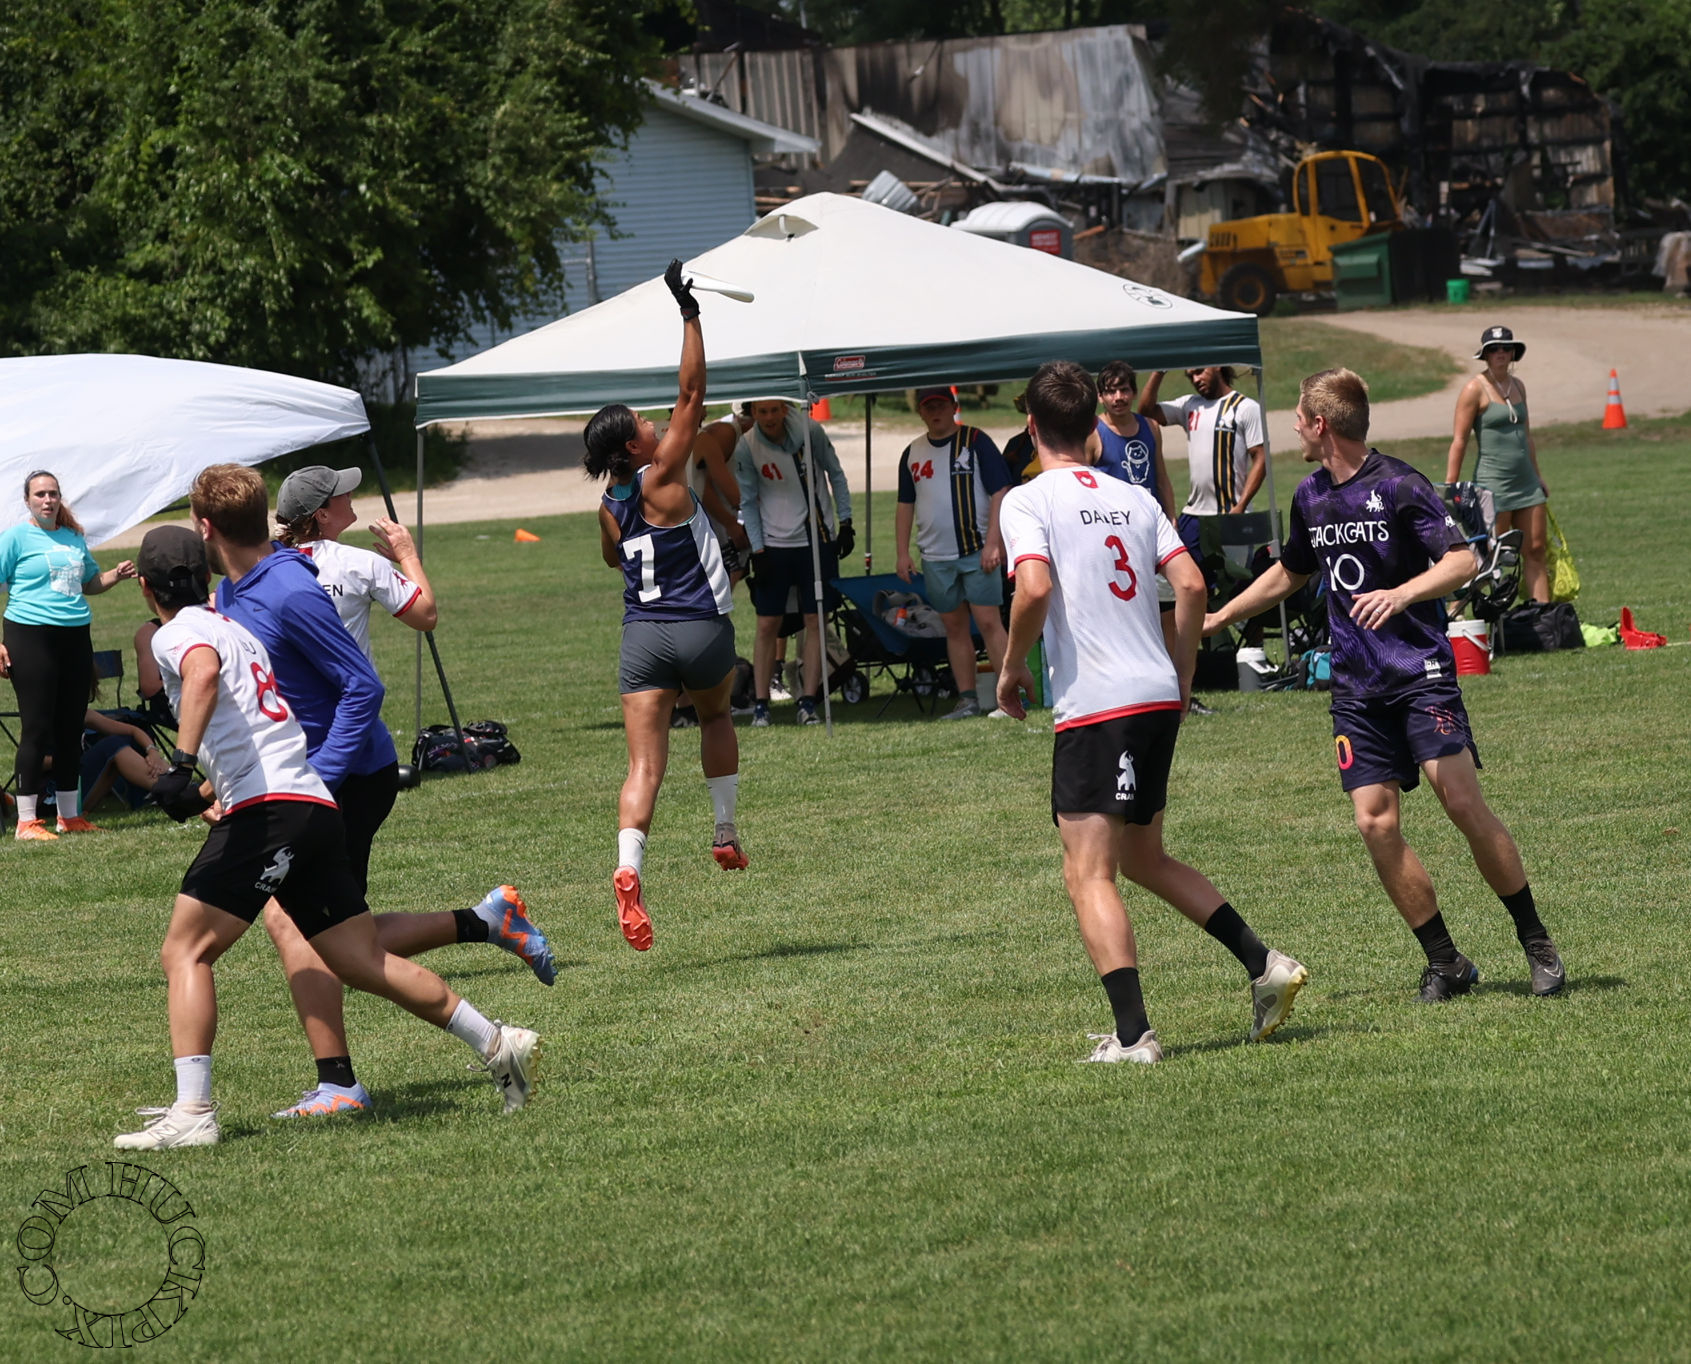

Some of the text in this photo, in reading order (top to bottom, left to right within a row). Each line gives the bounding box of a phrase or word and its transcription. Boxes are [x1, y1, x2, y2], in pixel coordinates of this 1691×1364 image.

[762, 463, 783, 480] 41
[911, 460, 934, 483] 24
[1080, 509, 1131, 526] DALEY
[623, 534, 662, 603] 7
[1104, 535, 1138, 602] 3
[1326, 553, 1365, 592] 10
[250, 661, 289, 722] 8
